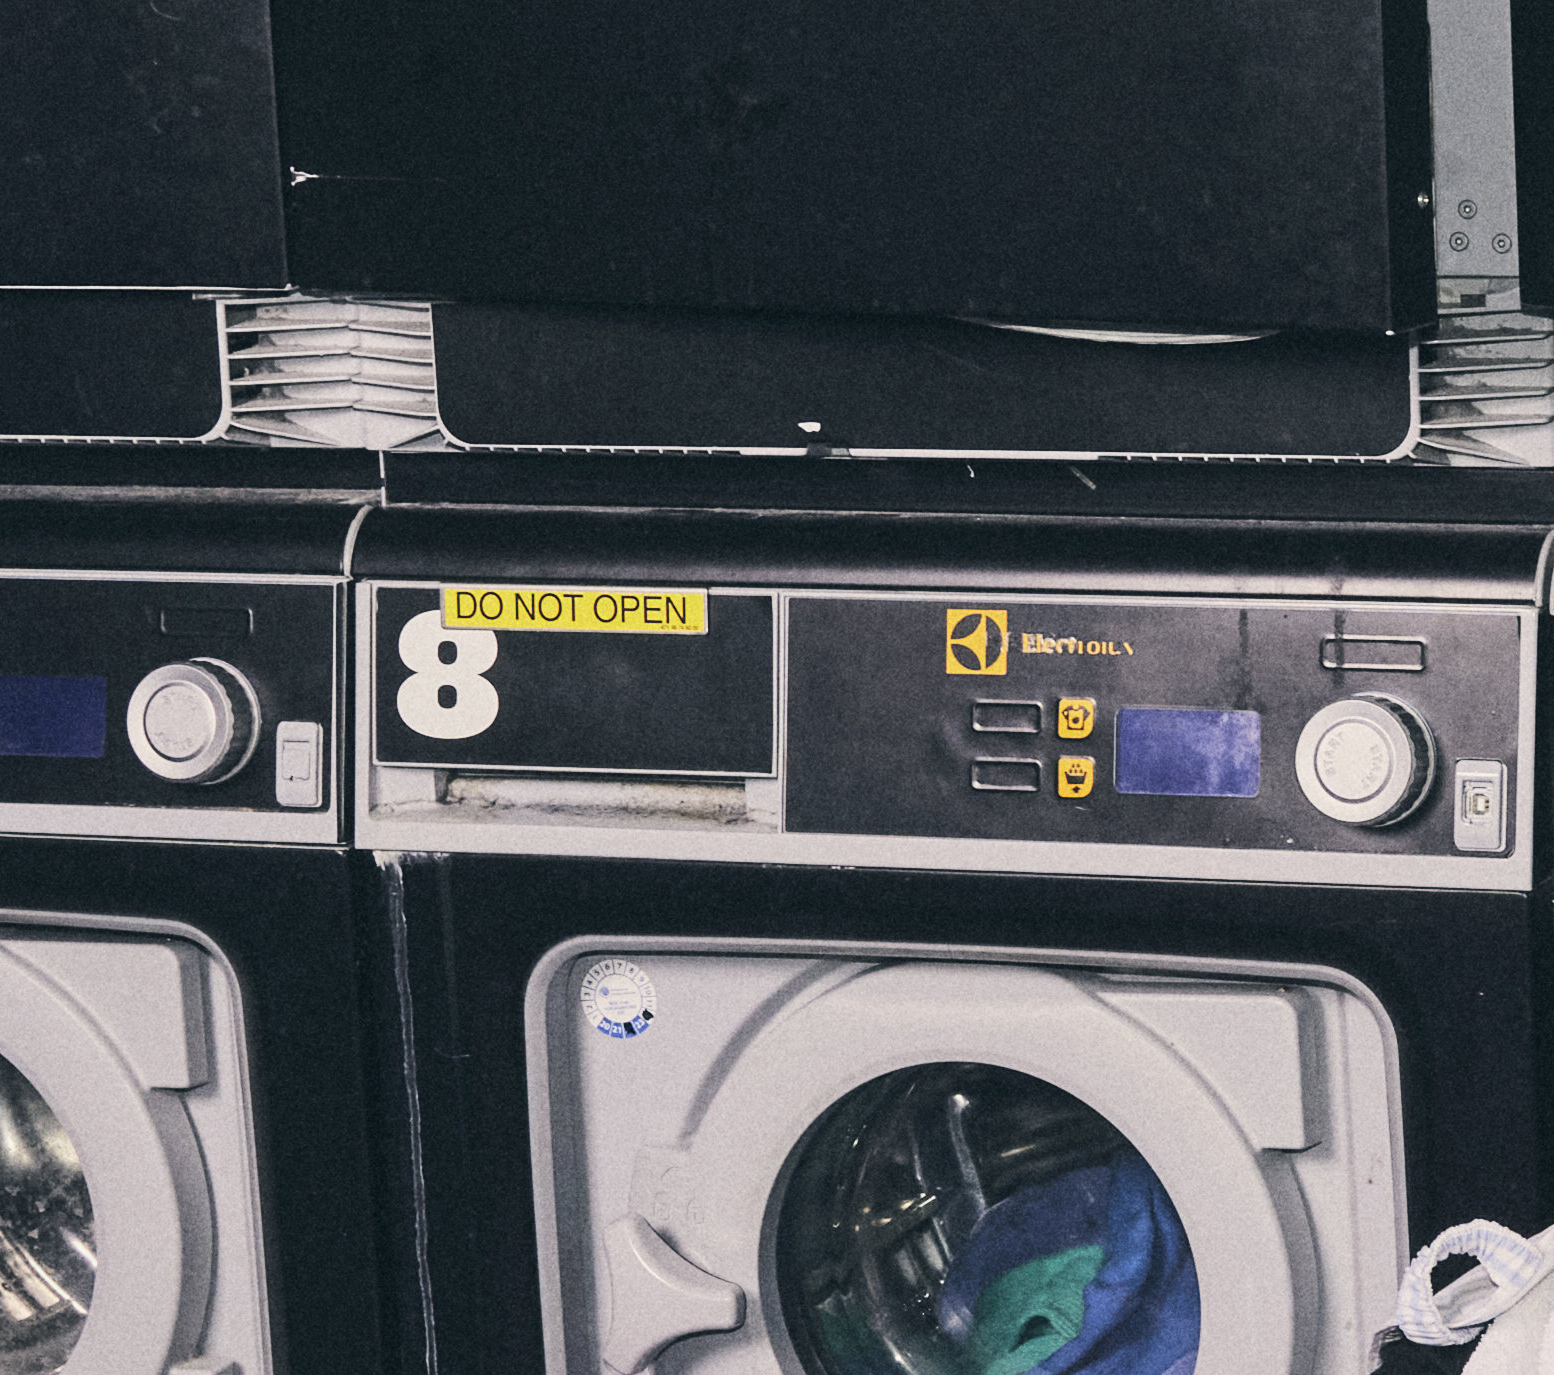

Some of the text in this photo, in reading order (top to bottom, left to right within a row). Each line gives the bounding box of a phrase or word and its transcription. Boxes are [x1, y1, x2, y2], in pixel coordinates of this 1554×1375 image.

[456, 591, 686, 624] DO NOT OPEN
[397, 610, 499, 739] 8
